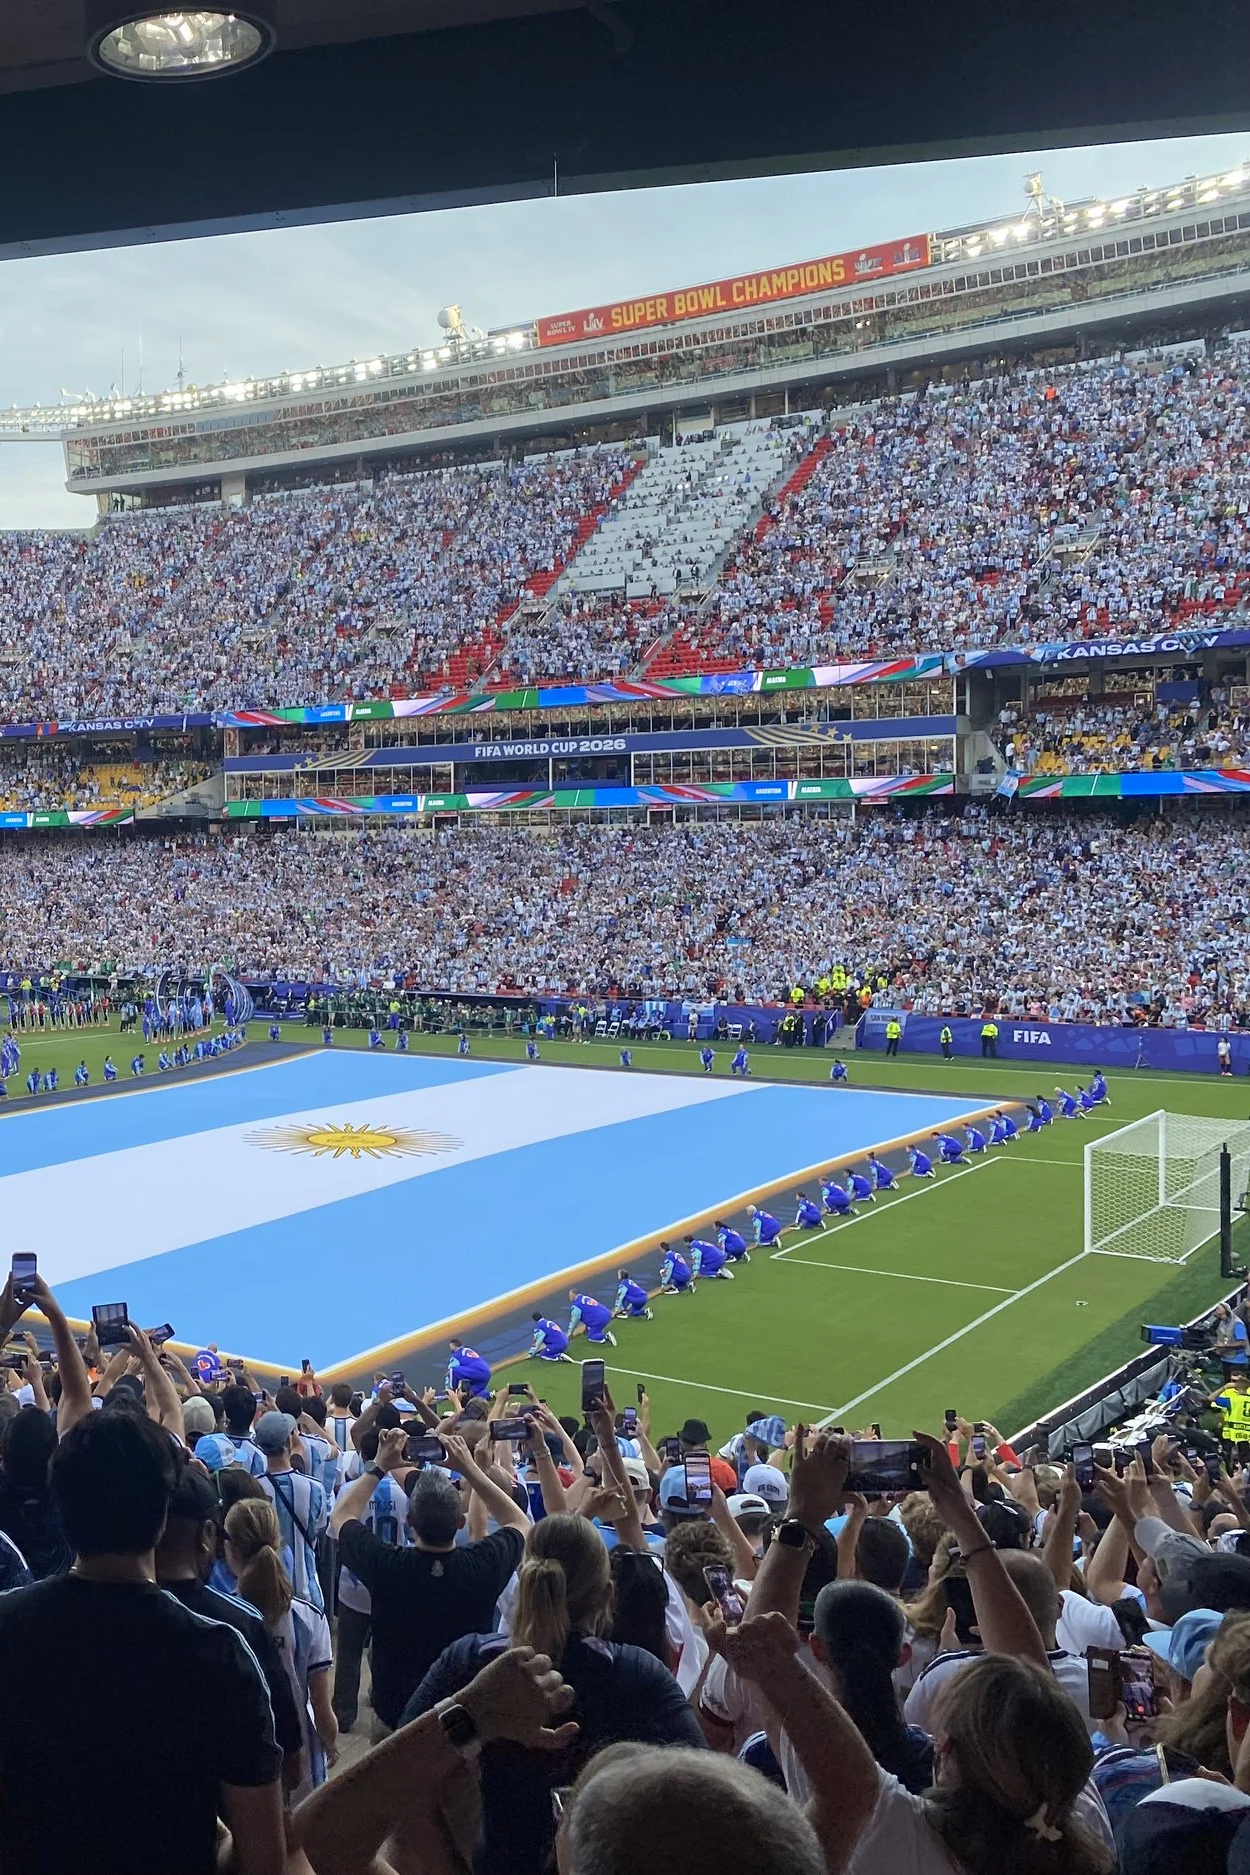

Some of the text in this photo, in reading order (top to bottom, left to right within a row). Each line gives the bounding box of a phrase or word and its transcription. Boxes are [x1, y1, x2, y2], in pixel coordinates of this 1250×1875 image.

[611, 297, 668, 328] SUPER
[674, 285, 727, 316] BOWL
[732, 258, 846, 303] CHAMPIONS
[546, 327, 568, 337] BOWL
[549, 319, 572, 330] SUPER
[1057, 635, 1220, 660] KANSAS CY
[68, 721, 123, 732] KANSAS
[474, 738, 627, 758] FIFA WORLD CUP 2026
[1013, 1030, 1052, 1045] FIFA
